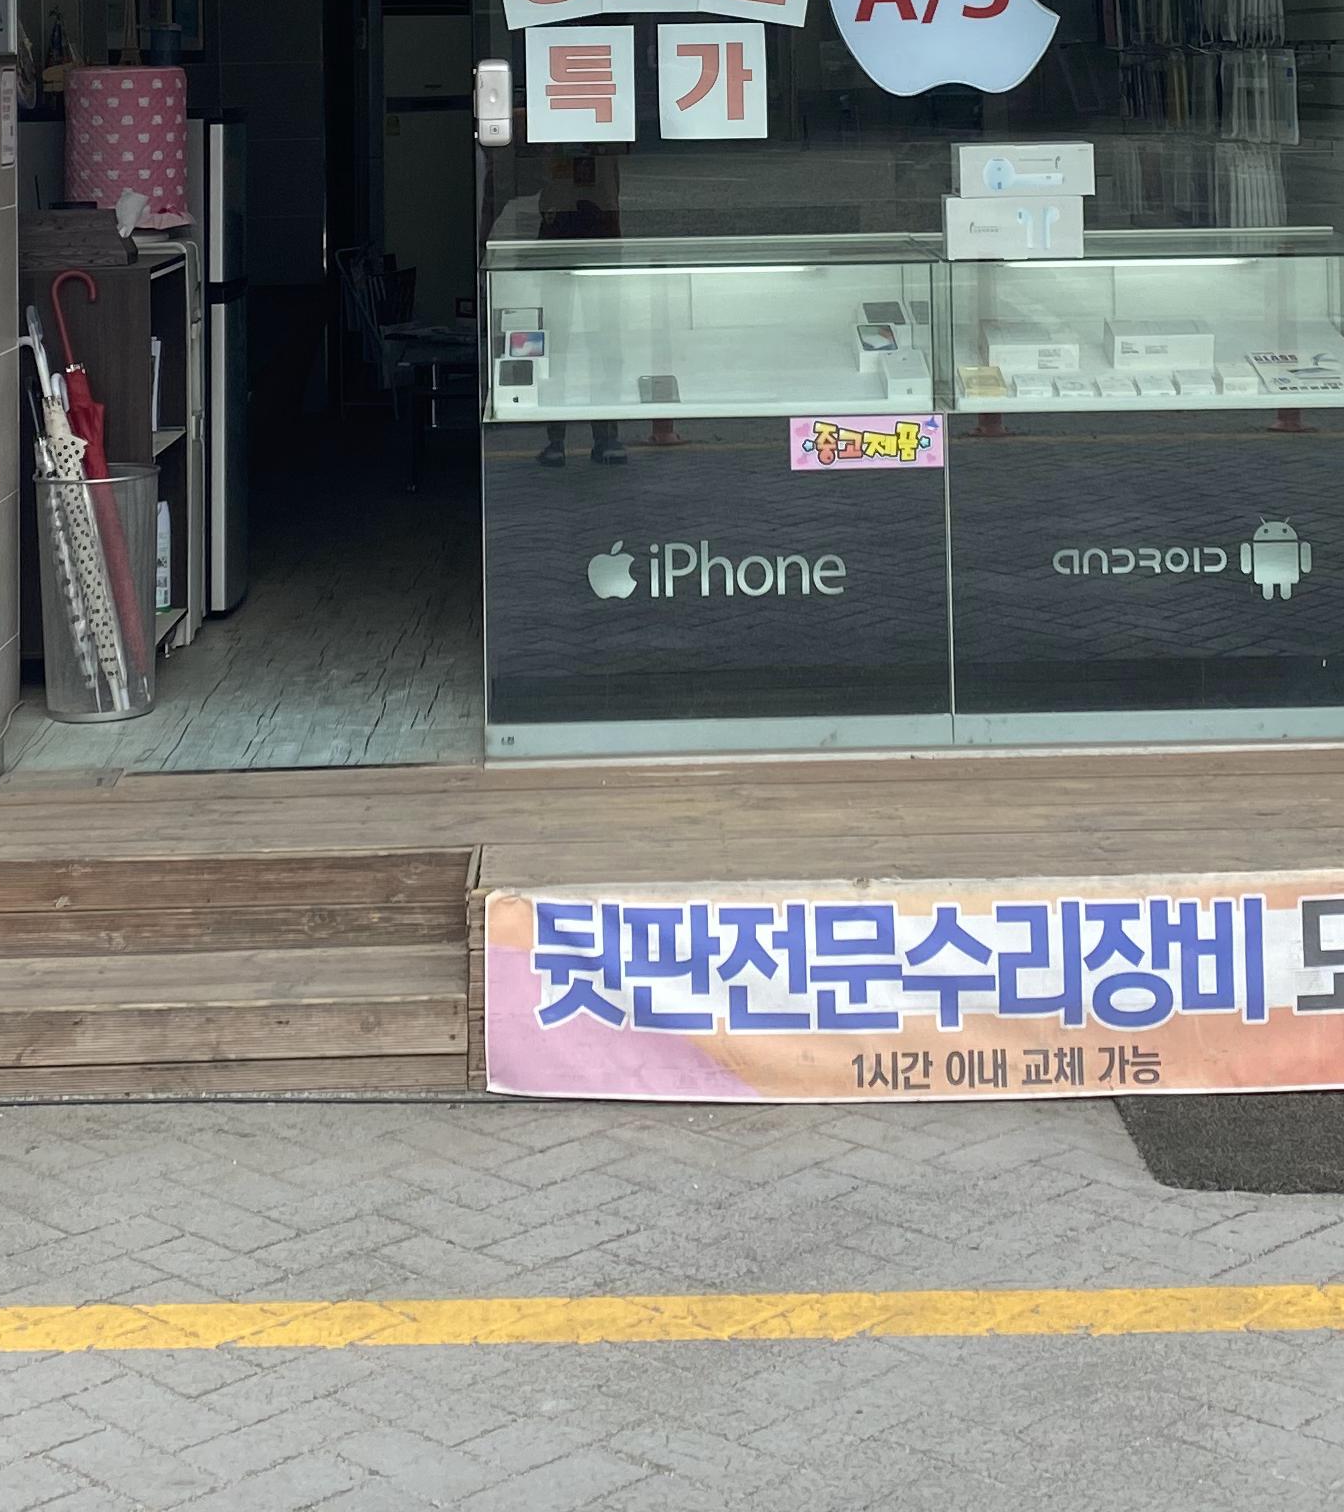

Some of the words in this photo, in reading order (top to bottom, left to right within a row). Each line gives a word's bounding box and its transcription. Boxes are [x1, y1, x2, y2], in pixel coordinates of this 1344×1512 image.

[545, 42, 754, 124] 특가
[813, 420, 920, 465] 중고제품
[649, 540, 846, 597] iPhone
[535, 896, 1263, 1030] 뒷판전문수리장비
[852, 1051, 933, 1090] 1시간
[946, 1048, 1008, 1088] 이내
[1022, 1047, 1085, 1086] 교체
[1098, 1045, 1161, 1085] 가능
